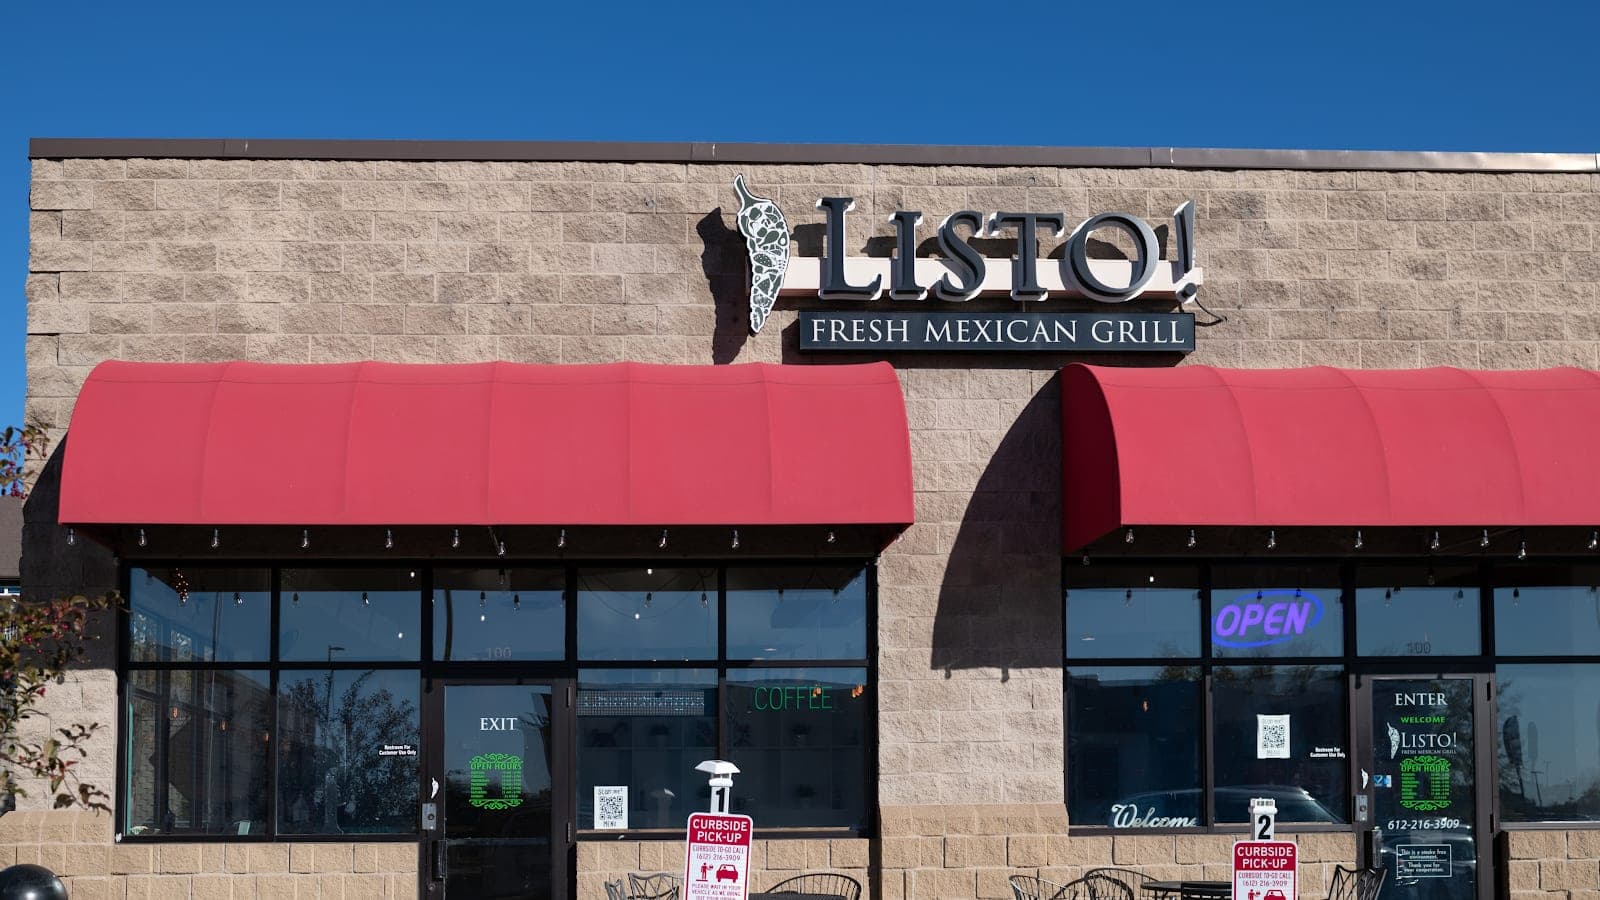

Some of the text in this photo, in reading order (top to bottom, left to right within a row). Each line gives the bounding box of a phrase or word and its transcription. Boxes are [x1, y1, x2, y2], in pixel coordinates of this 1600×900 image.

[815, 196, 1198, 303] LISTO!
[812, 319, 1185, 345] FRESH MEXICAN GRILL
[1215, 602, 1311, 637] OPEN
[488, 647, 512, 659] 100
[755, 686, 833, 710] COFFEE
[1395, 693, 1448, 706] ENTER
[480, 717, 518, 731] EXIT
[1400, 716, 1446, 724] WELCOME
[1401, 732, 1457, 748] LISTO!
[471, 762, 521, 770] OPEN HOURS
[1401, 764, 1450, 772] OPEN HOURS
[716, 787, 725, 812] 1
[693, 819, 748, 831] CURBSIDE
[1258, 814, 1271, 840] 2
[1387, 819, 1460, 830] 612-216-3909
[697, 831, 742, 843] PICK-UP
[692, 845, 716, 853] CURBSIDE
[732, 846, 744, 854] CALL
[1237, 847, 1294, 857] CURBSIDE
[1242, 858, 1288, 869] PICK-UP
